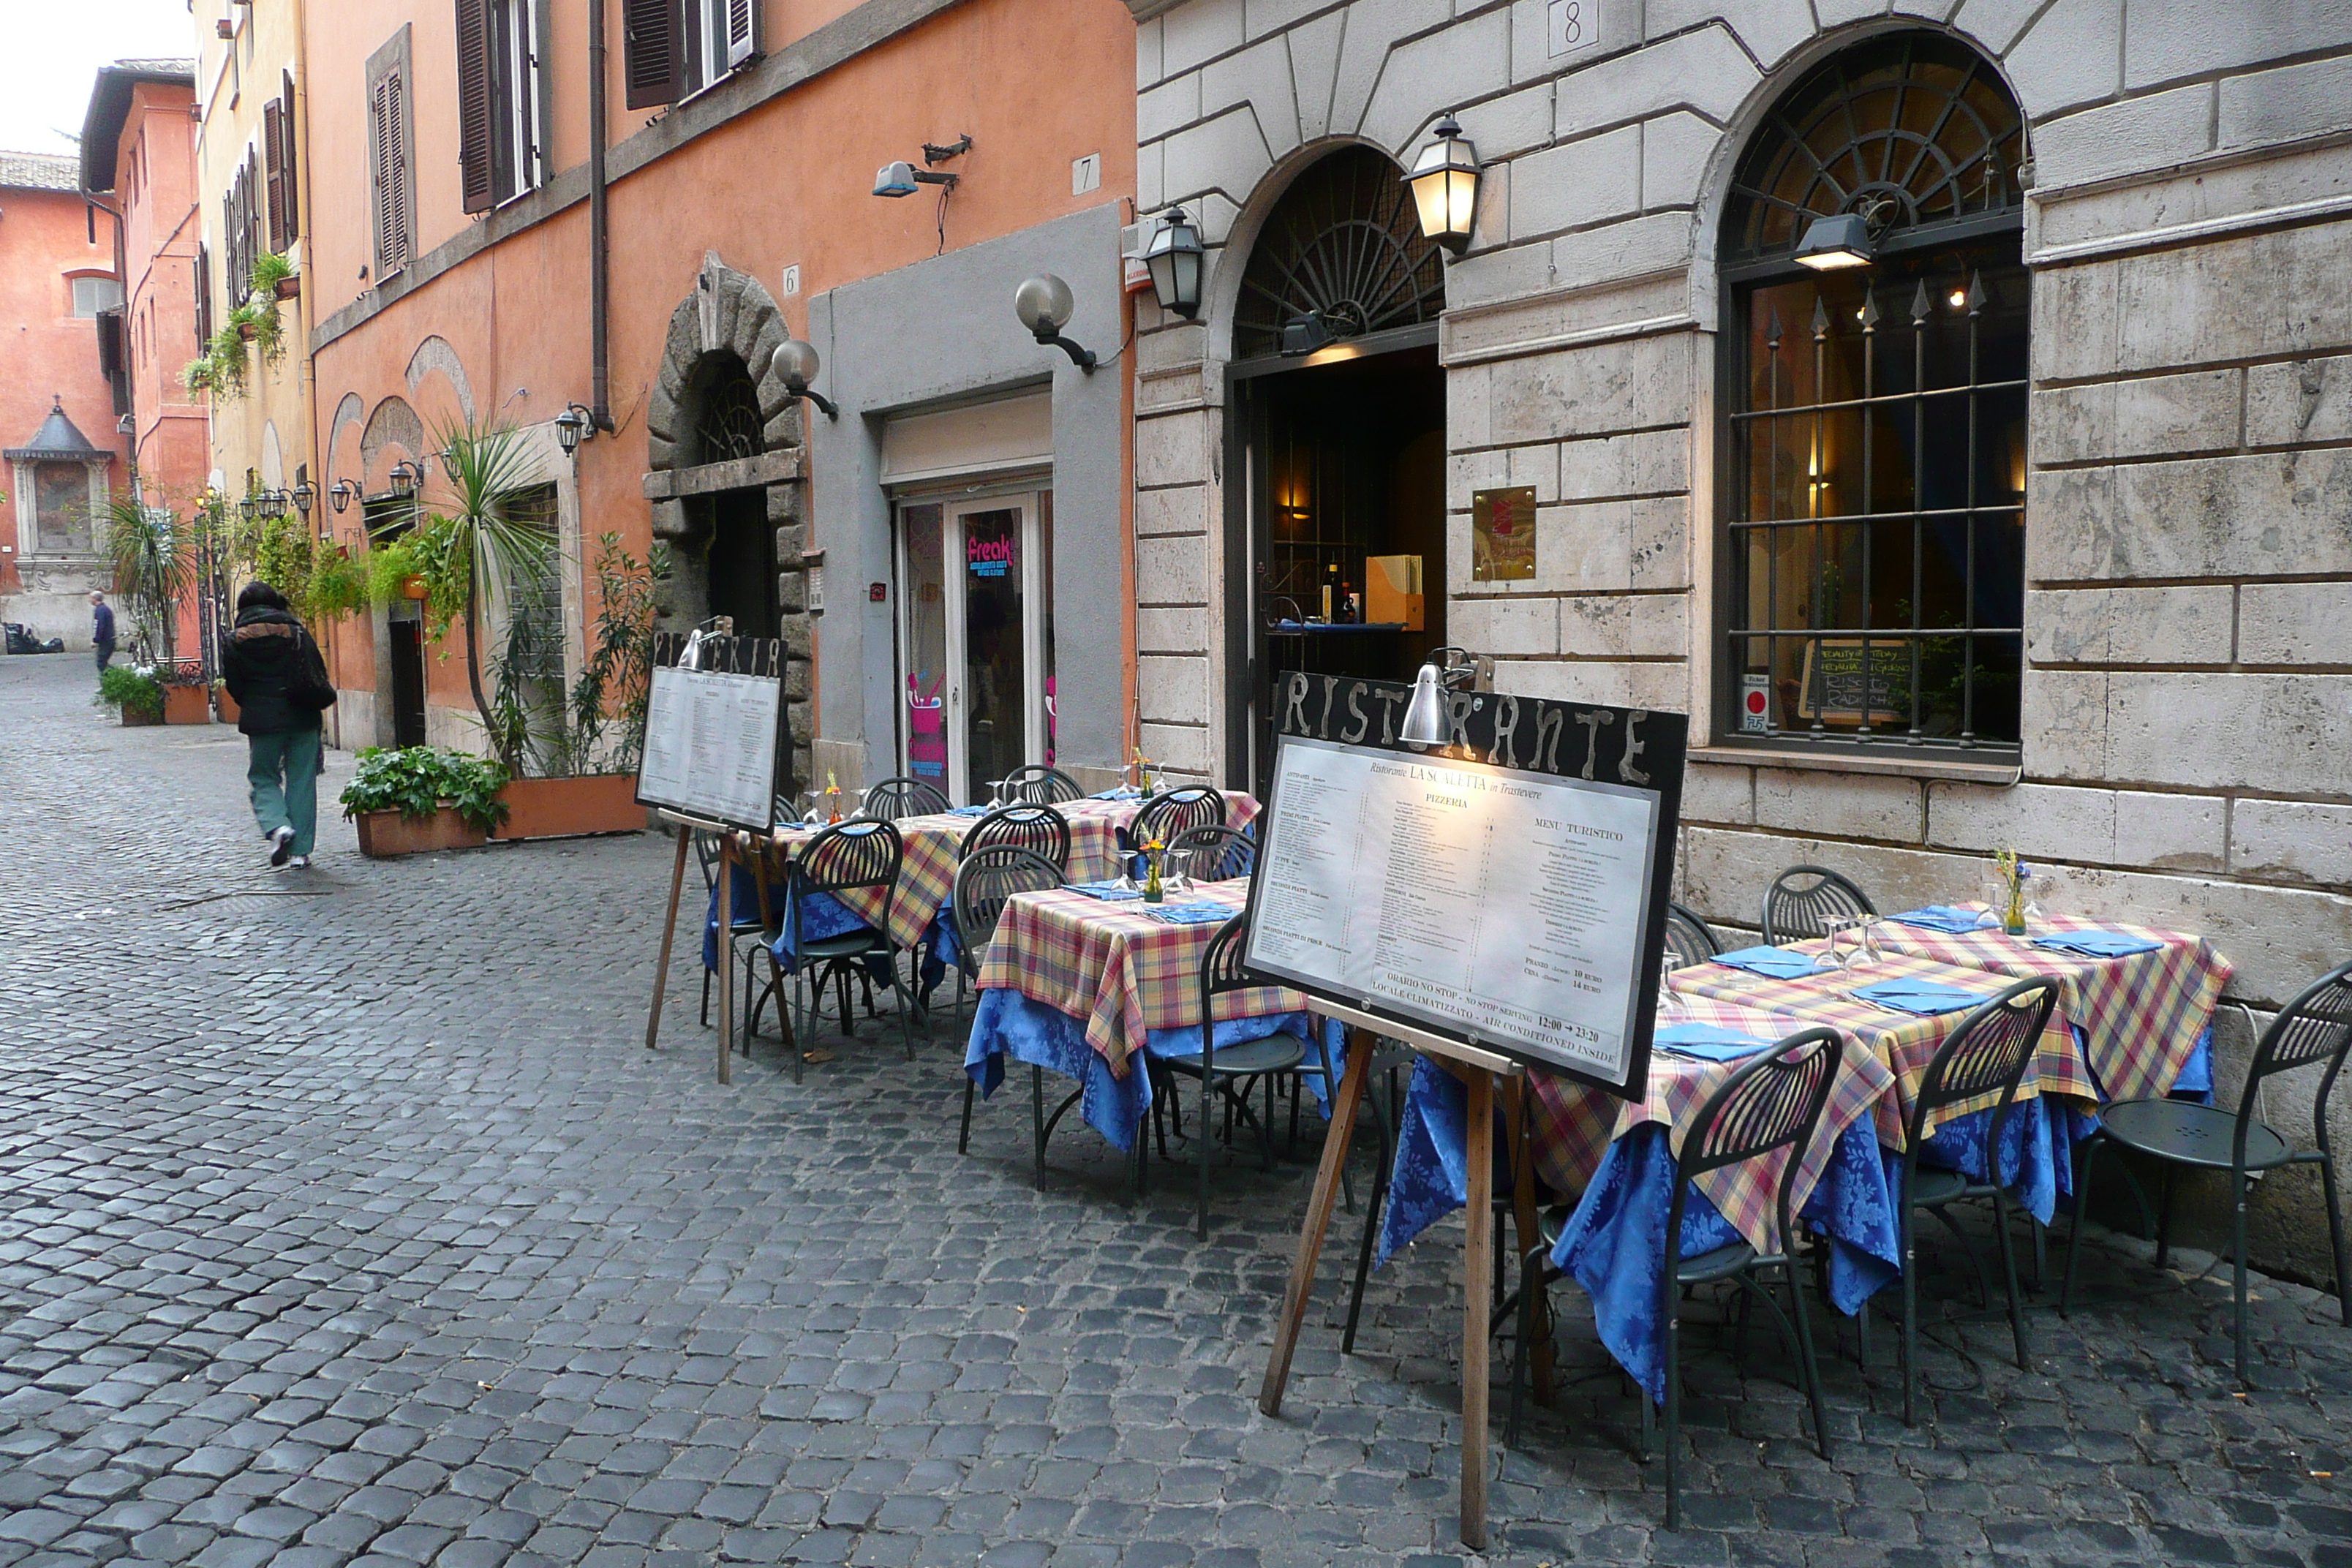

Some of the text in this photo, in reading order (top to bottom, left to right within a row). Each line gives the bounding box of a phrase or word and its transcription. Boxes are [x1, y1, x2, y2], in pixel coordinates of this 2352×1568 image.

[1566, 1, 1580, 43] 8
[1081, 158, 1091, 189] 7
[786, 268, 795, 292] 6
[652, 632, 780, 677] PIERIA
[1284, 672, 1650, 785] RISTRANTE
[1371, 761, 1543, 800] Ristorante LA SCALETTA in Trastevere
[1425, 793, 1468, 809] PIZZERIA
[1534, 818, 1624, 842] MENU TURISTICO
[1573, 980, 1581, 989] 14
[1583, 984, 1602, 994] EURO
[1574, 969, 1583, 979] 10
[1584, 973, 1602, 984] EURO
[1372, 981, 1616, 1064] LOCALE CLIMATIZZATO AIR CONDITIONED INSIDE
[1387, 972, 1599, 1044] ORARIO NO STOP NO STOP SERVING 12:00 23:20
